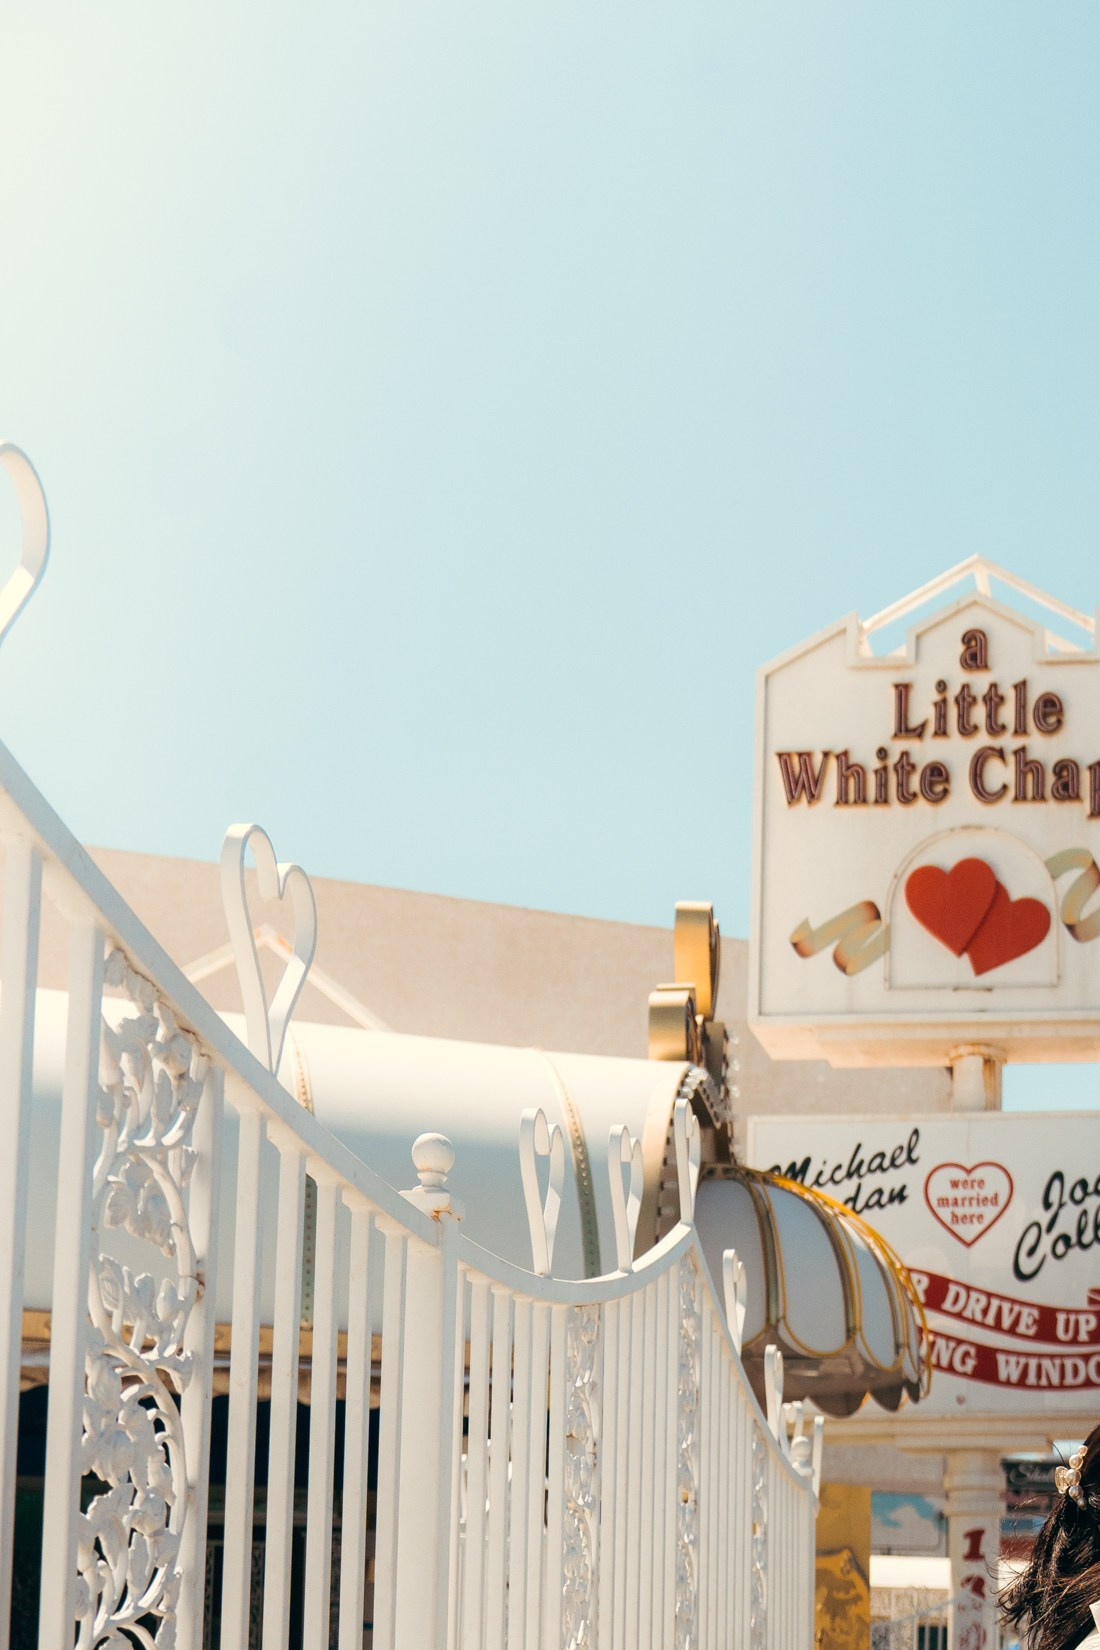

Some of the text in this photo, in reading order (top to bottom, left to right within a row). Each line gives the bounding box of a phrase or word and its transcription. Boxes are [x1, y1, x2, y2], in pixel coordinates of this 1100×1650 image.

[959, 628, 990, 672] a
[892, 678, 1064, 741] Little
[775, 747, 950, 807] White
[768, 1128, 919, 1187] Michael
[844, 1182, 908, 1214] dan
[937, 1192, 999, 1208] married
[949, 1179, 985, 1189] were
[951, 1211, 984, 1225] here
[941, 1283, 1040, 1337] DRIVE
[1055, 1311, 1098, 1342] UP
